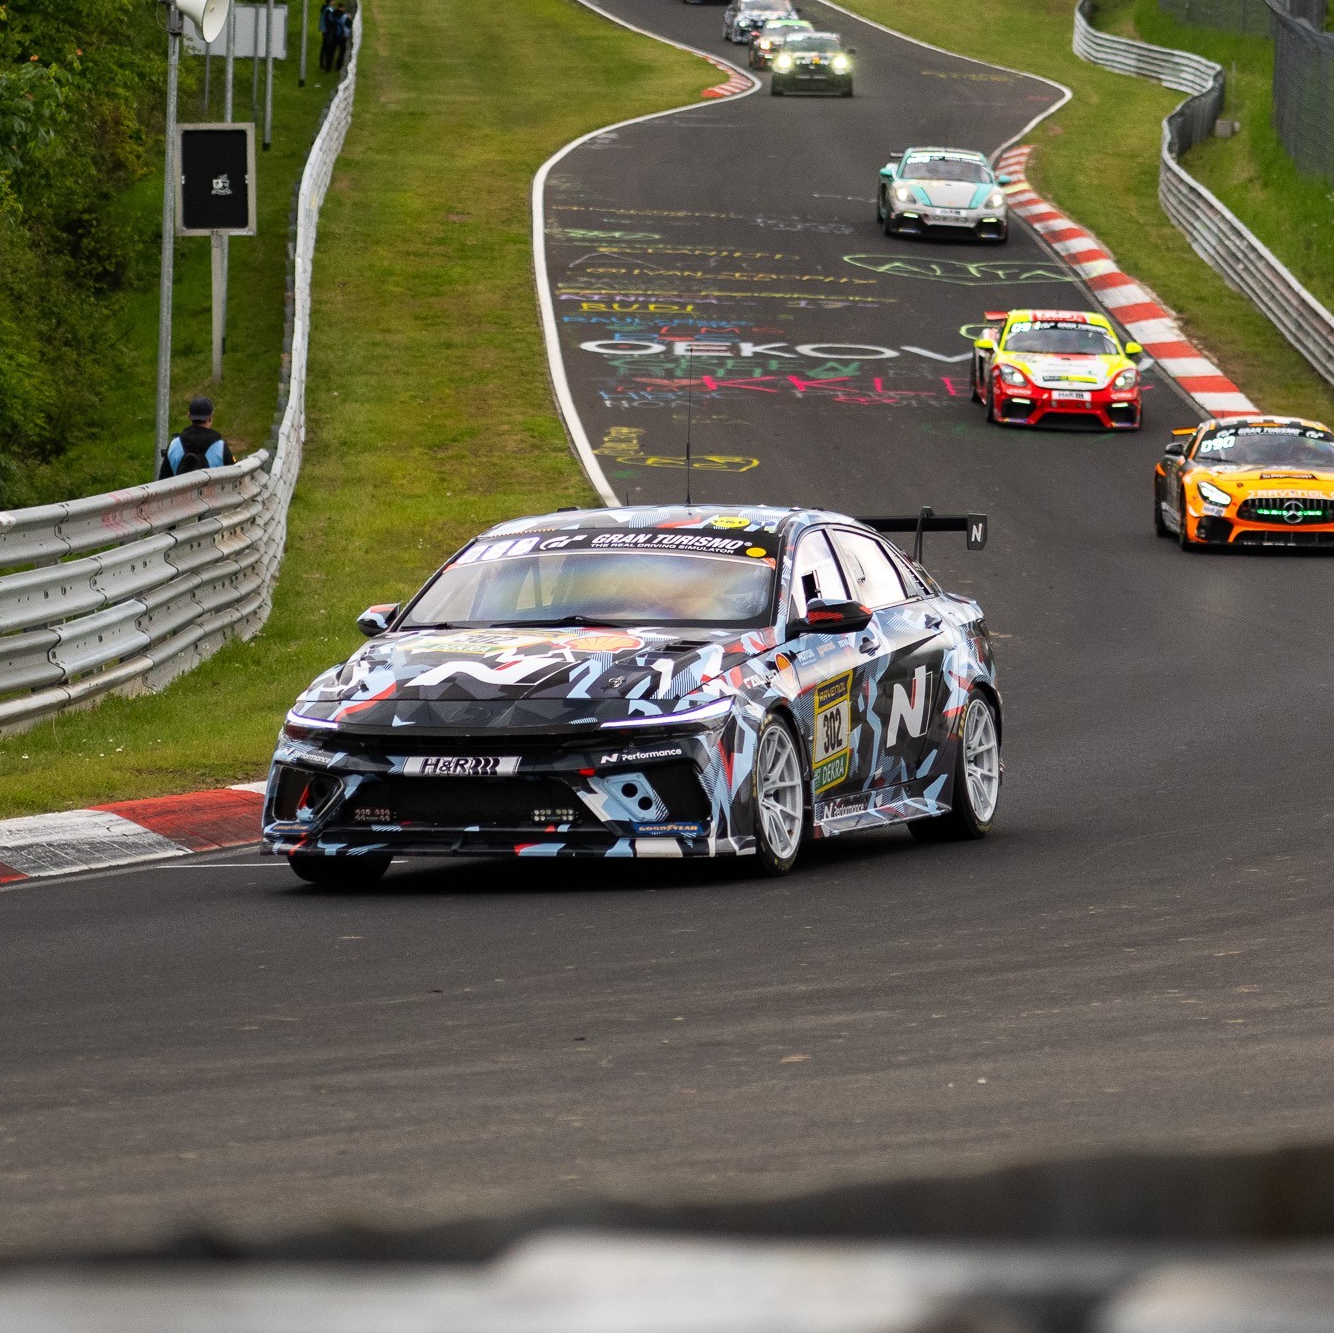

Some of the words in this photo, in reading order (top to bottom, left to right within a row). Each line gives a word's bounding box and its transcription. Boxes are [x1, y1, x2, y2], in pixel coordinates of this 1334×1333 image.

[1238, 427, 1261, 436] GRAN
[591, 533, 652, 544] GRAN
[971, 523, 983, 542] N
[678, 544, 735, 554] SIMULATOR
[886, 665, 933, 749] N
[823, 707, 843, 754] 302
[622, 748, 683, 762] Performance
[419, 757, 471, 775] H&R
[822, 759, 845, 785] DEKRA
[834, 803, 865, 818] Performance
